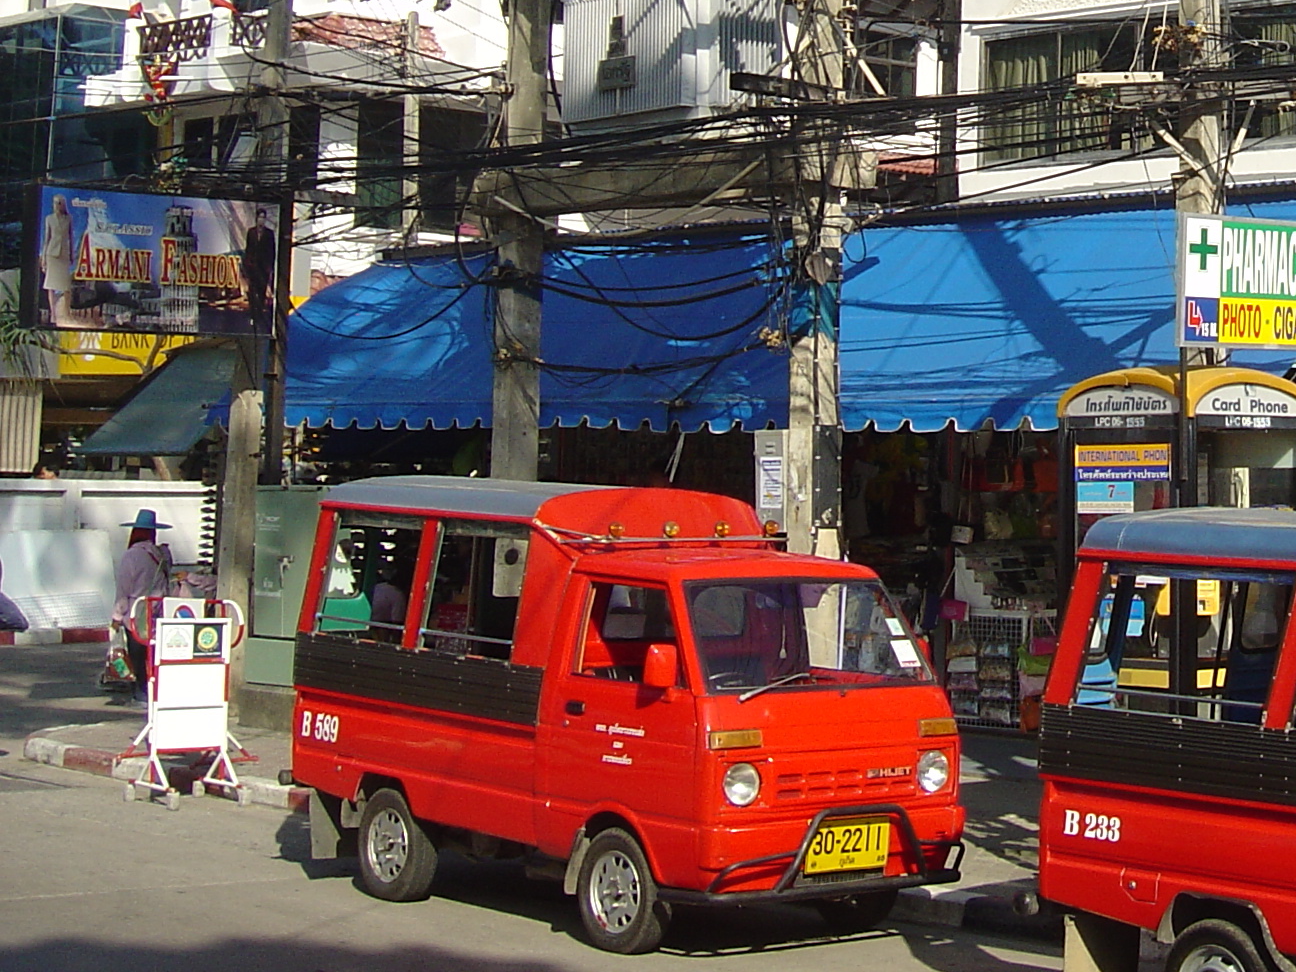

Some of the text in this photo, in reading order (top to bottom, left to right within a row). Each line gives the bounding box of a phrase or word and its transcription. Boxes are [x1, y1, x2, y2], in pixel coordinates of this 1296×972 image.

[74, 229, 241, 290] ARMANI FASHION
[1221, 303, 1262, 339] PHOTO
[1211, 397, 1289, 414] Card Phone
[1078, 448, 1168, 463] INTERNATIONAL PHON
[1107, 484, 1116, 499] 7
[301, 710, 339, 743] B 589
[879, 765, 913, 777] HIJET
[811, 824, 882, 856] 30-2211
[1063, 809, 1121, 843] B 233
